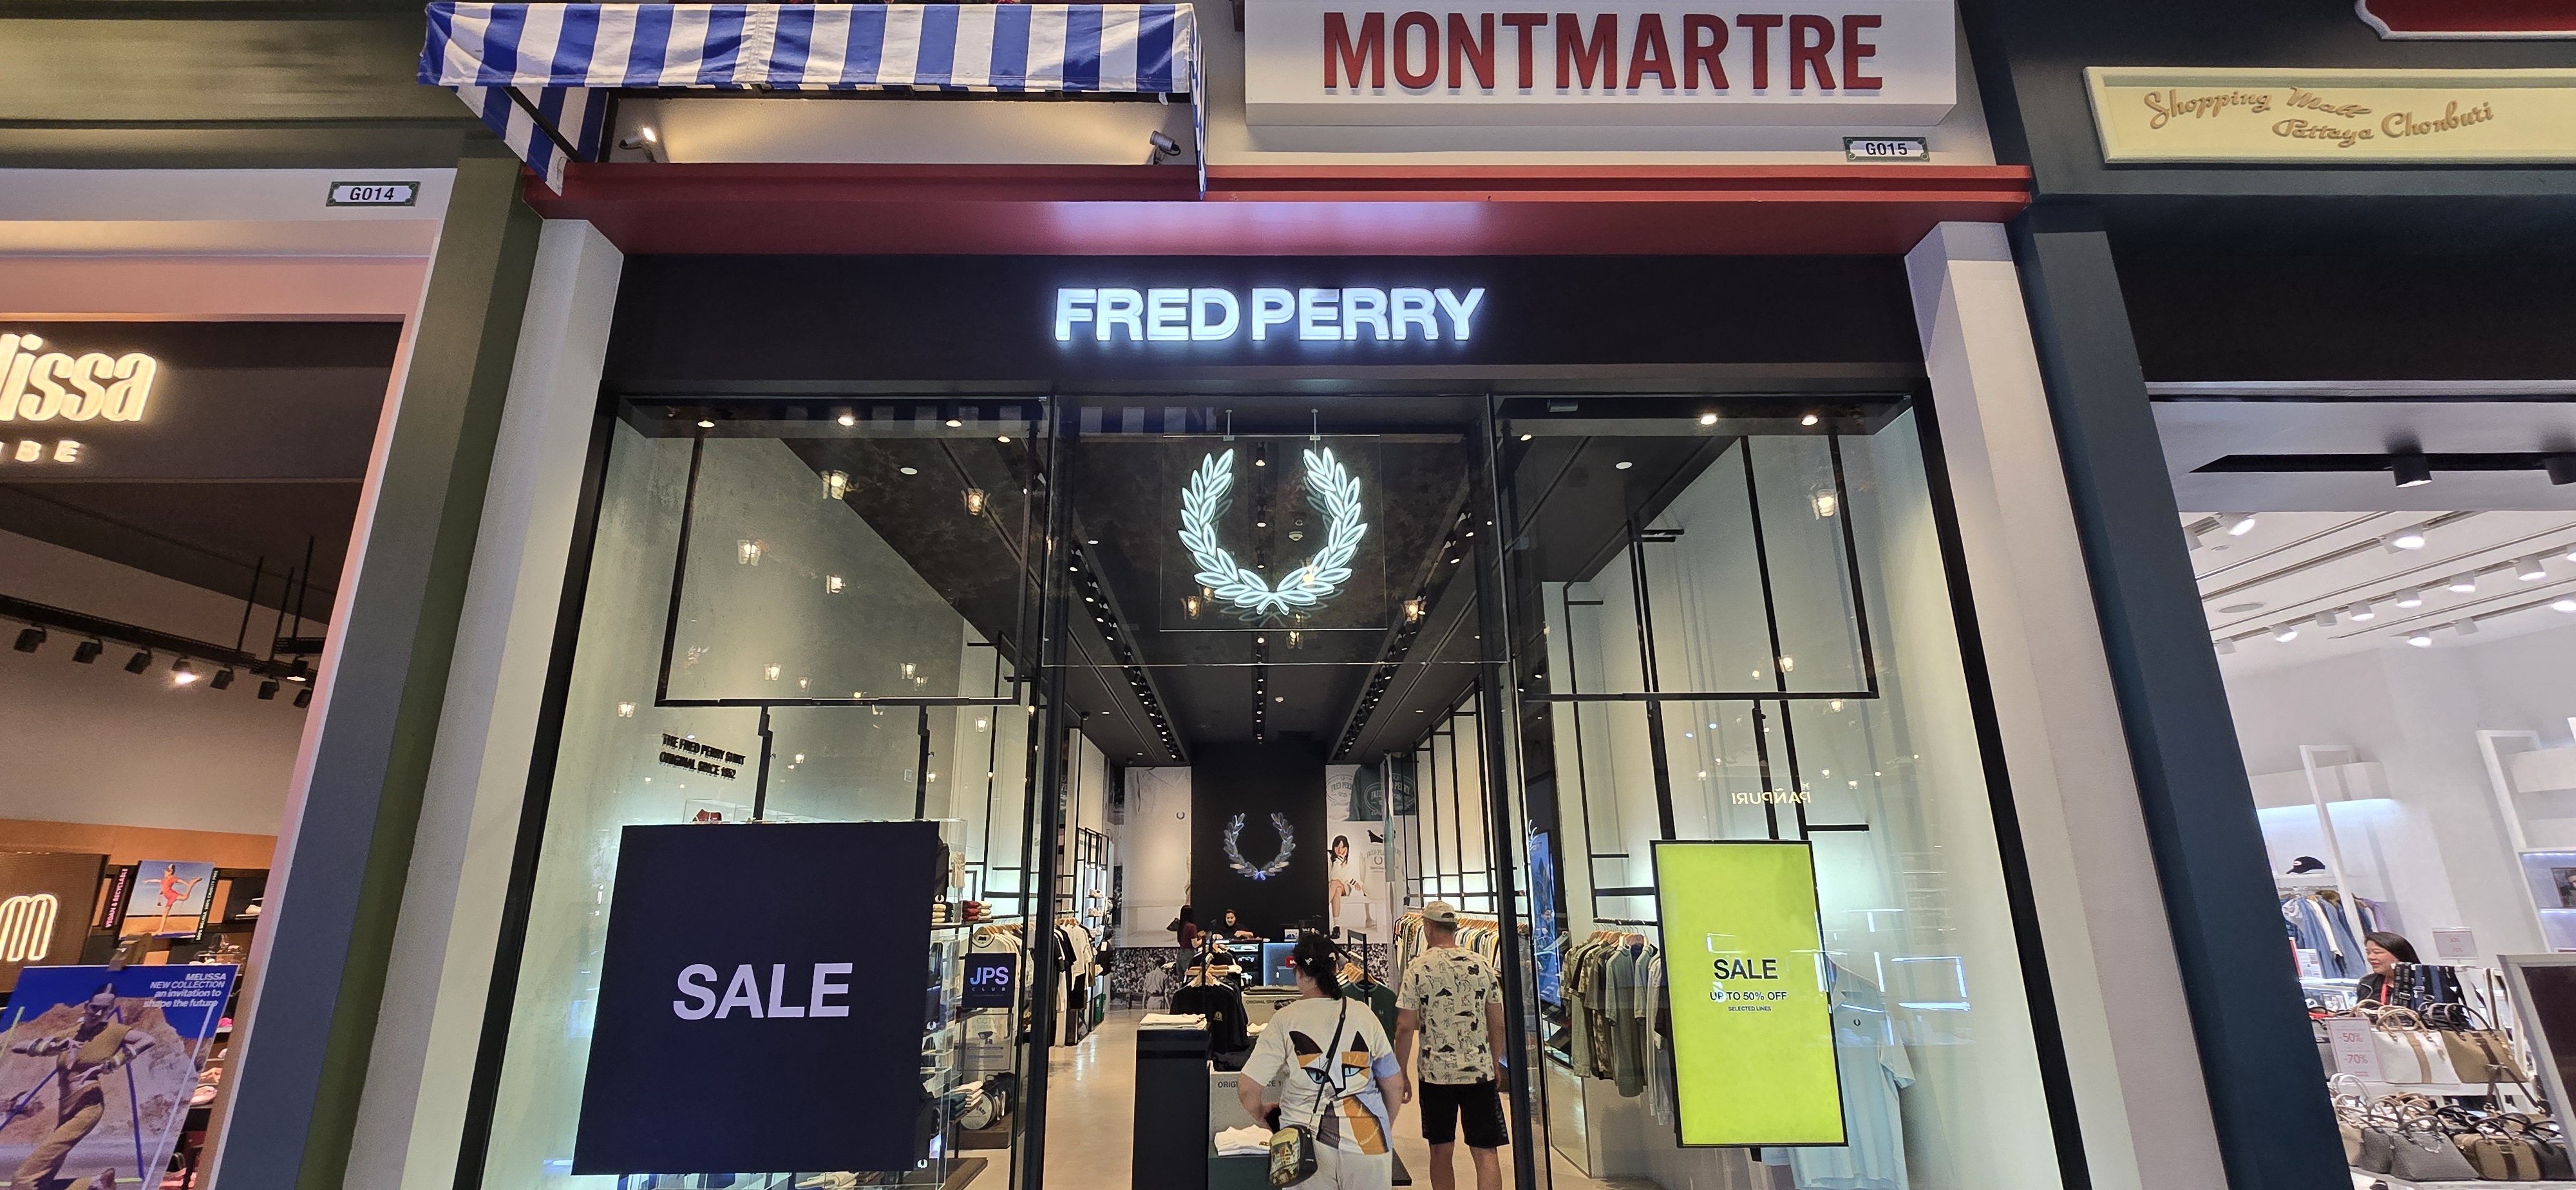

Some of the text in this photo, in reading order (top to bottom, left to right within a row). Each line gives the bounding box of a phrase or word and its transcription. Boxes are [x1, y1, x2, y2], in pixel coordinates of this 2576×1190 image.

[1323, 12, 1883, 90] MONTMARTRE
[2145, 87, 2372, 129] Shopping Mall
[2272, 100, 2494, 148] Pattaya Chonburi
[1865, 142, 1908, 155] G015
[350, 187, 395, 200] G014
[1055, 288, 1484, 341] FRED PERRY
[679, 738, 701, 753] FRED
[700, 744, 726, 760] PERRY
[970, 967, 1009, 985] JPS
[1714, 959, 1778, 979] SALE
[167, 989, 211, 997] invitation
[211, 989, 222, 997] to
[674, 963, 853, 1020] SALE
[1710, 992, 1787, 1000] UP TO 50% OFF
[173, 999, 189, 1007] the
